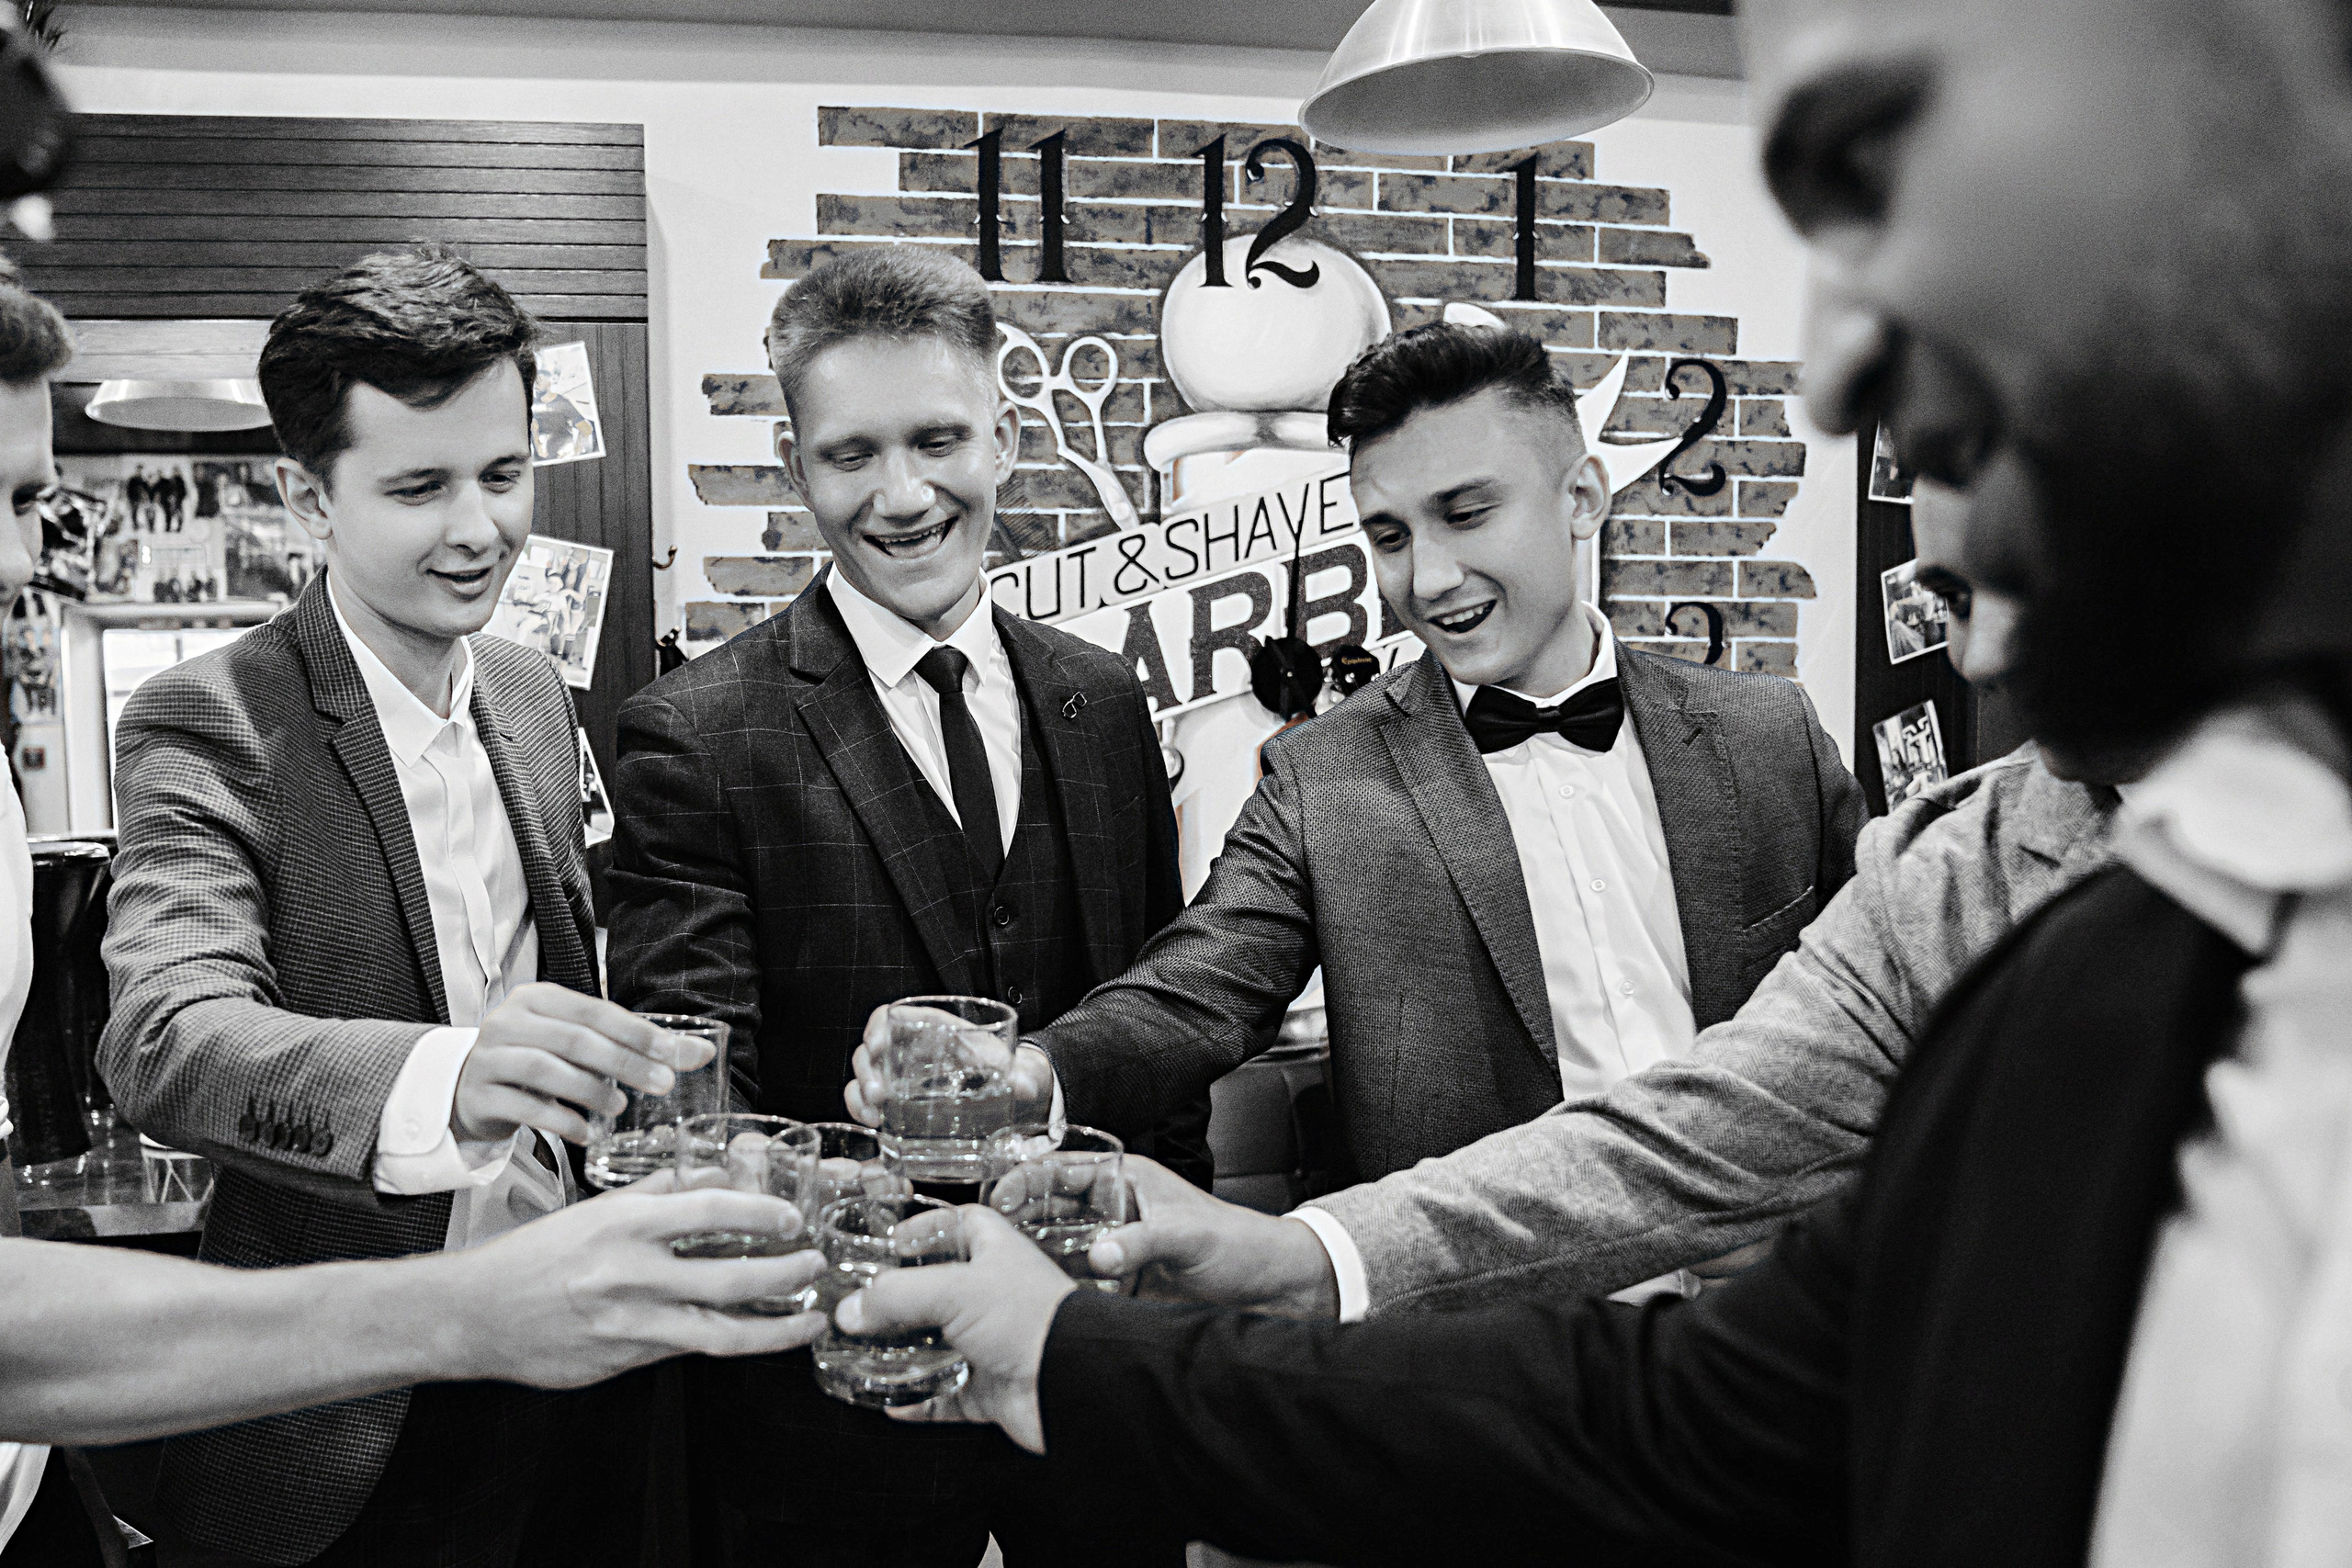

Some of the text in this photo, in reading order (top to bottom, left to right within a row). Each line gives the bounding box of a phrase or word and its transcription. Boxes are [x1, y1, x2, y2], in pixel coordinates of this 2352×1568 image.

[963, 128, 1073, 283] 11
[1193, 133, 1320, 289] 12
[1492, 152, 1540, 301] 1
[1658, 358, 1726, 497] 2
[1114, 534, 1160, 595] &
[1164, 472, 1354, 581] SHAVE
[1121, 543, 1409, 713] ARB
